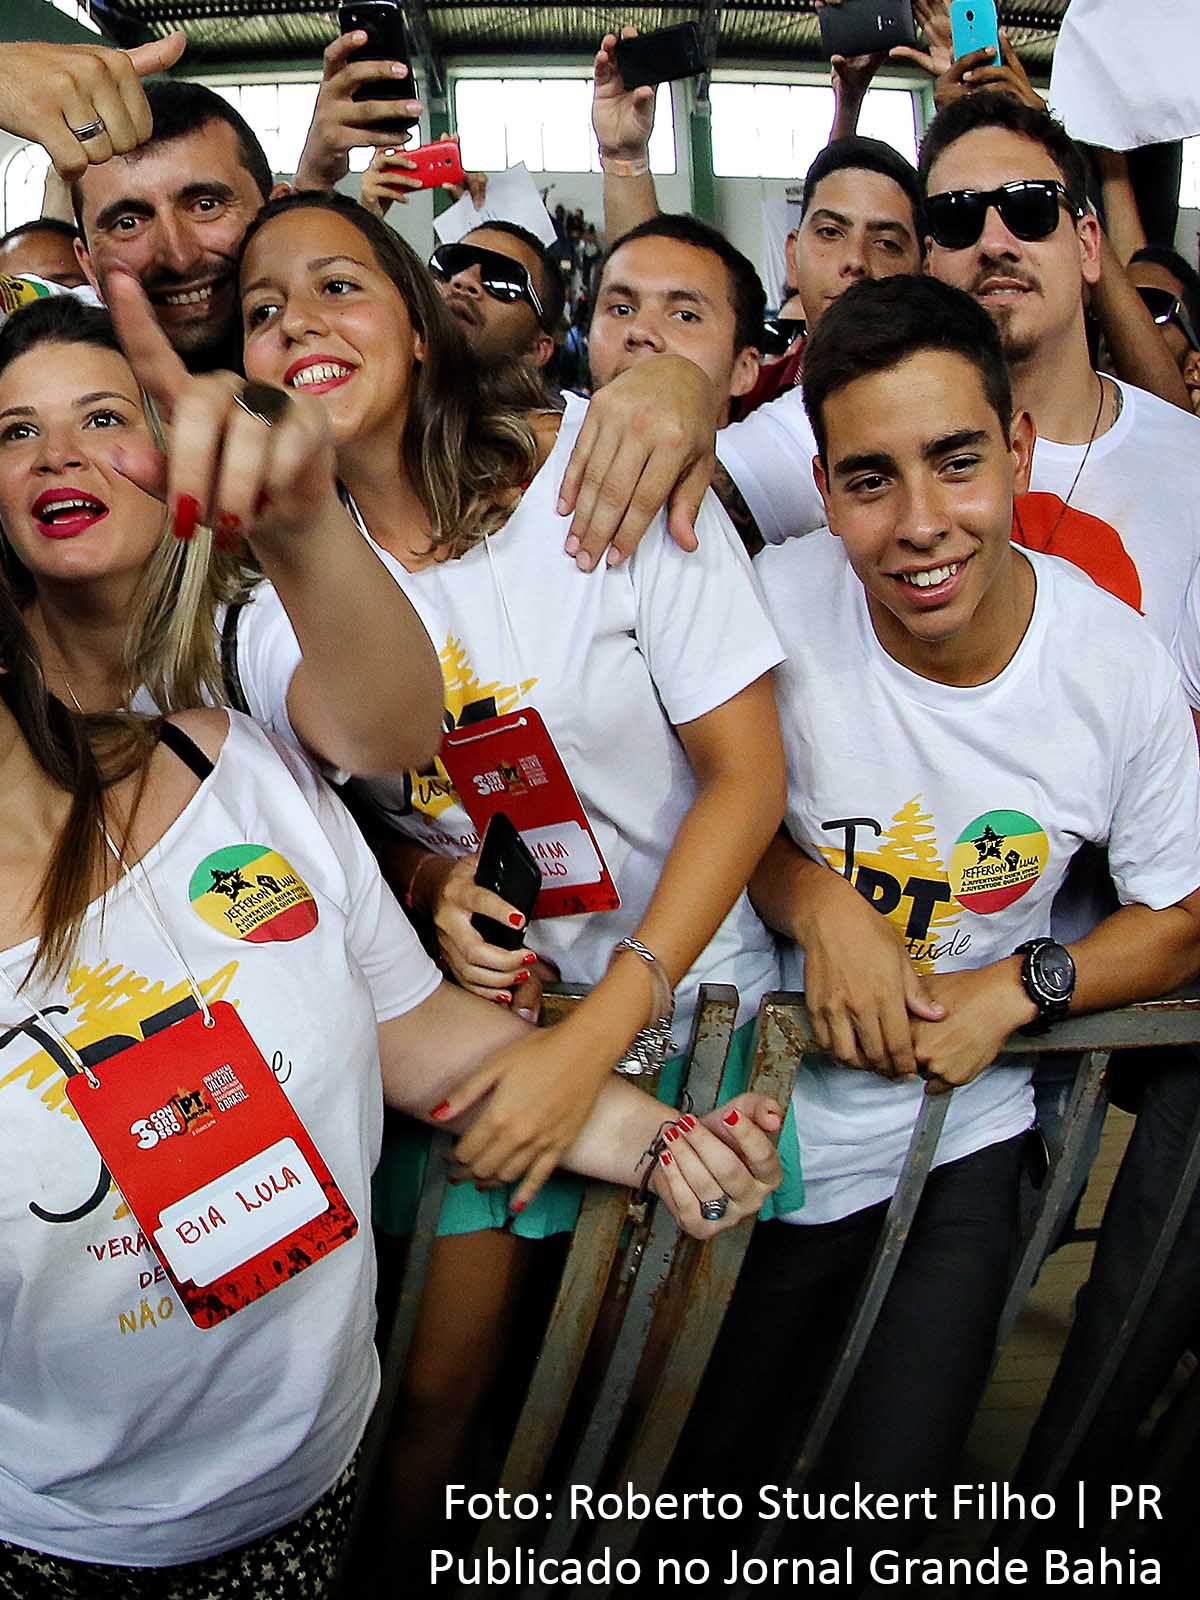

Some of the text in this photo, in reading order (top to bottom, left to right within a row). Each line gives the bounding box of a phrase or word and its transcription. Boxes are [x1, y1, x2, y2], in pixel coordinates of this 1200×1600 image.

[961, 862, 1007, 880] JEFFERSON
[224, 886, 272, 923] JEFFERSON
[206, 1070, 237, 1092] VALENTE
[176, 1167, 301, 1244] BIA LULA
